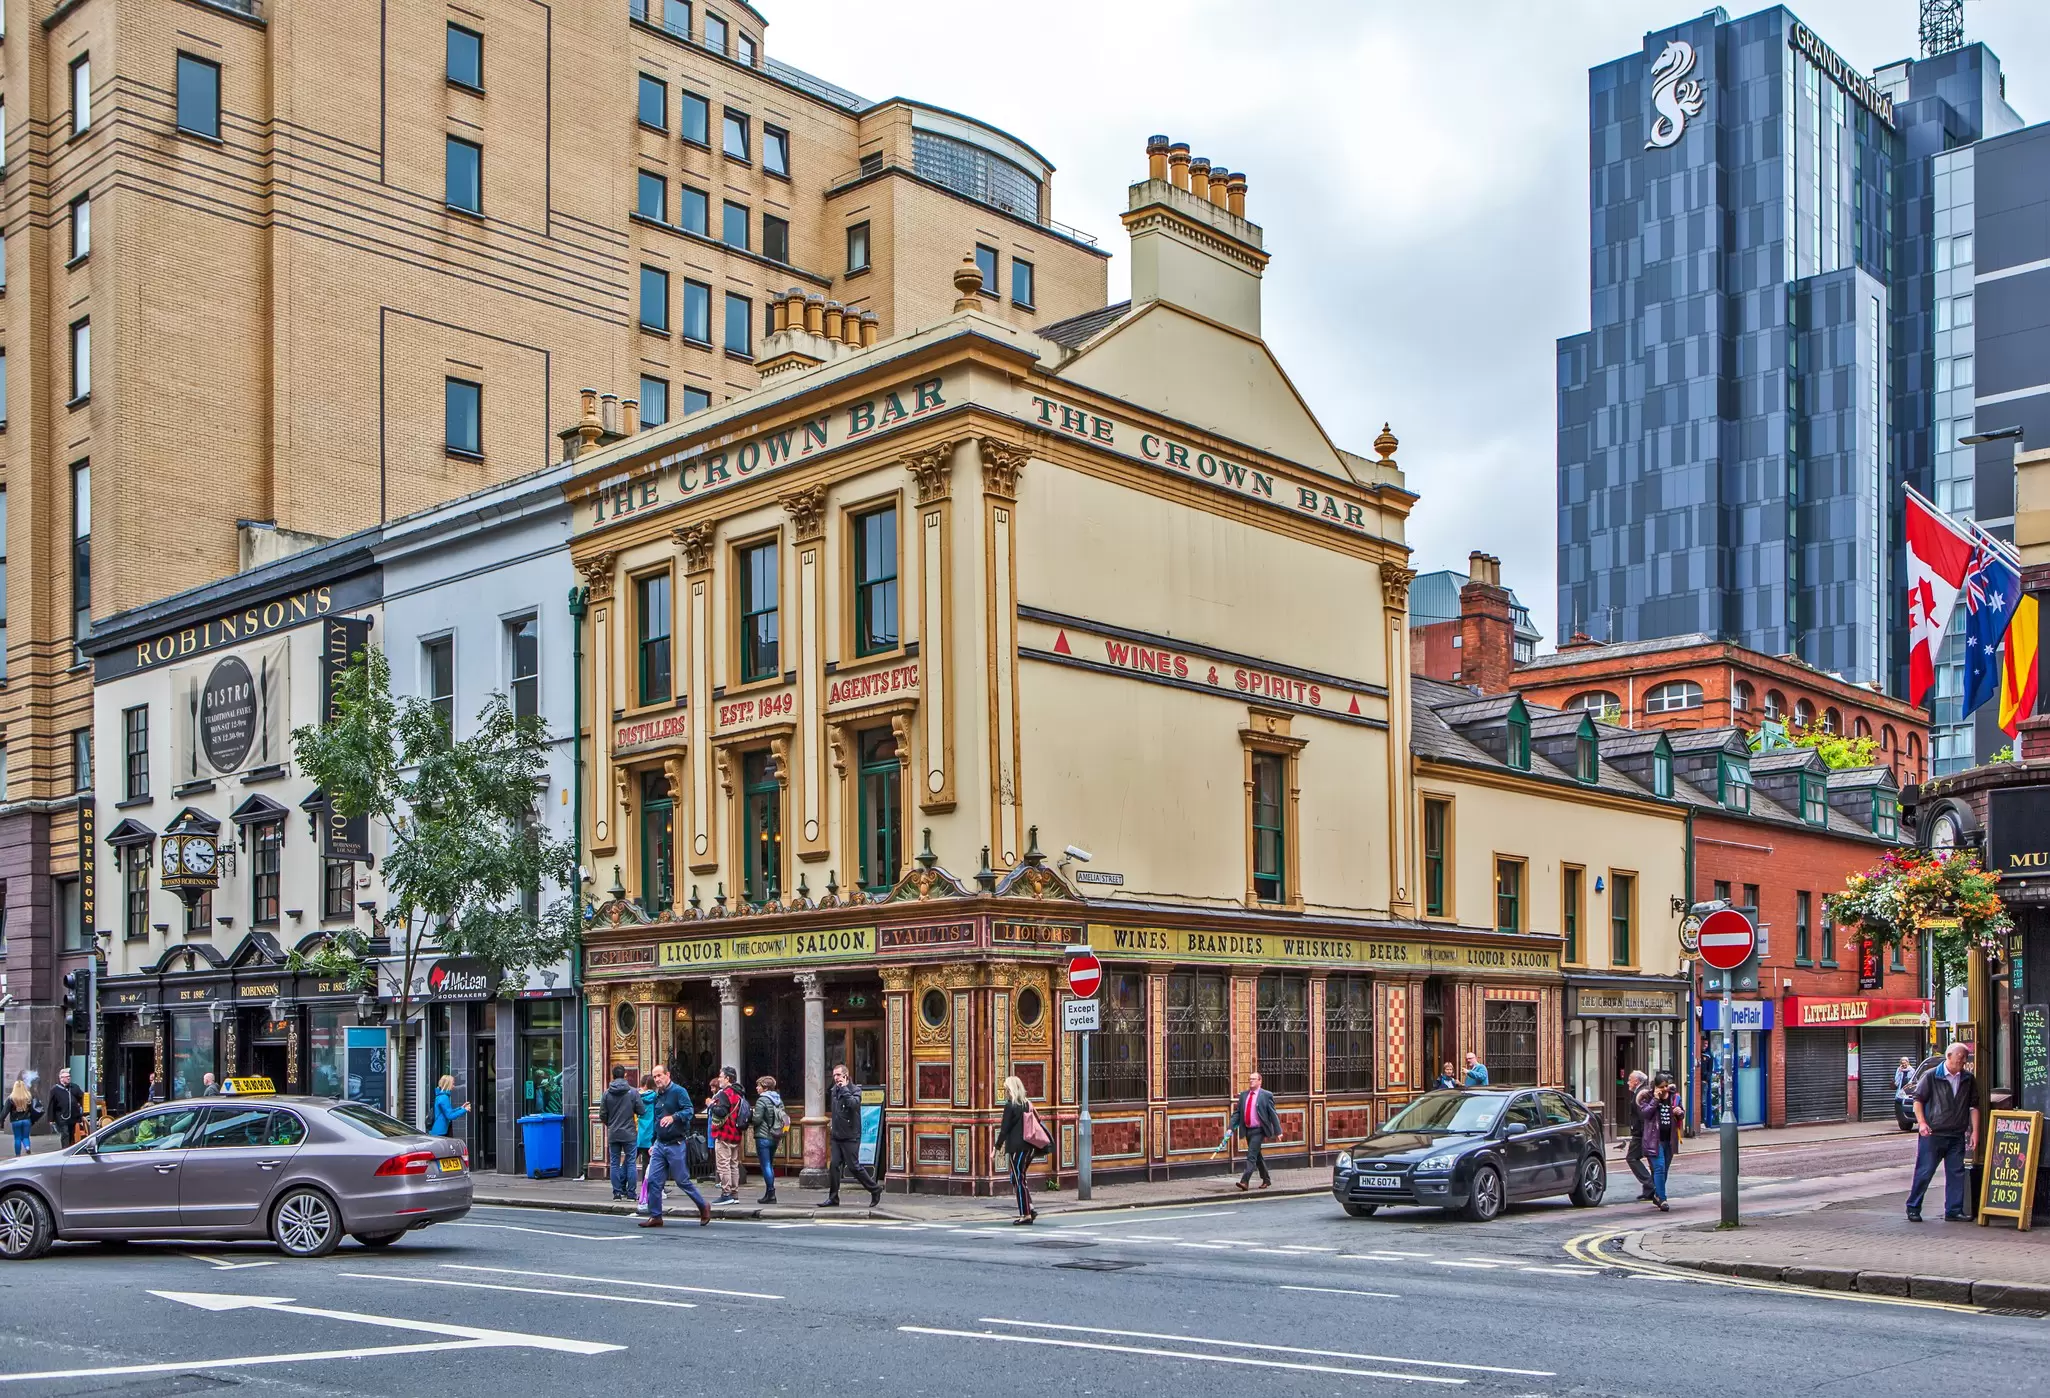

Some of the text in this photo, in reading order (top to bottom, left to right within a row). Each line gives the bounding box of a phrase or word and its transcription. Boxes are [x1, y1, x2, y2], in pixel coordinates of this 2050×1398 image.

[1796, 22, 1895, 129] GRAND CENTRAL
[589, 376, 946, 527] THE CROWN BAR
[1032, 397, 1365, 529] THE CROWN BAR
[136, 586, 332, 666] ROBINSON'S
[331, 620, 347, 684] DAILY
[1105, 640, 1321, 706] WINES & SPIRITS
[207, 683, 249, 708] BISTRO
[829, 672, 890, 705] AGENTS
[205, 706, 252, 724] TRADITIONAL FAYRE
[758, 692, 793, 720] 1849
[212, 735, 222, 744] SUN
[617, 715, 686, 748] DISTILLERS
[83, 808, 94, 924] ROBINSONS
[1078, 872, 1122, 884] AMELIA STREET
[893, 925, 960, 944] VAULTS
[601, 950, 642, 964] SPIRIT
[667, 942, 722, 962] LIQUOR
[751, 940, 783, 956] CROWN
[1468, 950, 1505, 966] LIQUOR
[1864, 940, 1873, 977] PIZZA
[318, 983, 331, 992] EST.
[1068, 1004, 1095, 1014] Except
[1582, 996, 1673, 1009] THE CROWN DINING ROOMS
[1803, 1001, 1868, 1023] LITTLE ITALY
[1070, 1016, 1094, 1026] cycles
[1722, 1007, 1760, 1024] ineFlair
[1999, 1142, 2020, 1155] FISH
[2005, 1157, 2011, 1168] &
[1361, 1176, 1397, 1187] HNZ 6074
[1995, 1167, 2019, 1181] CHIPS
